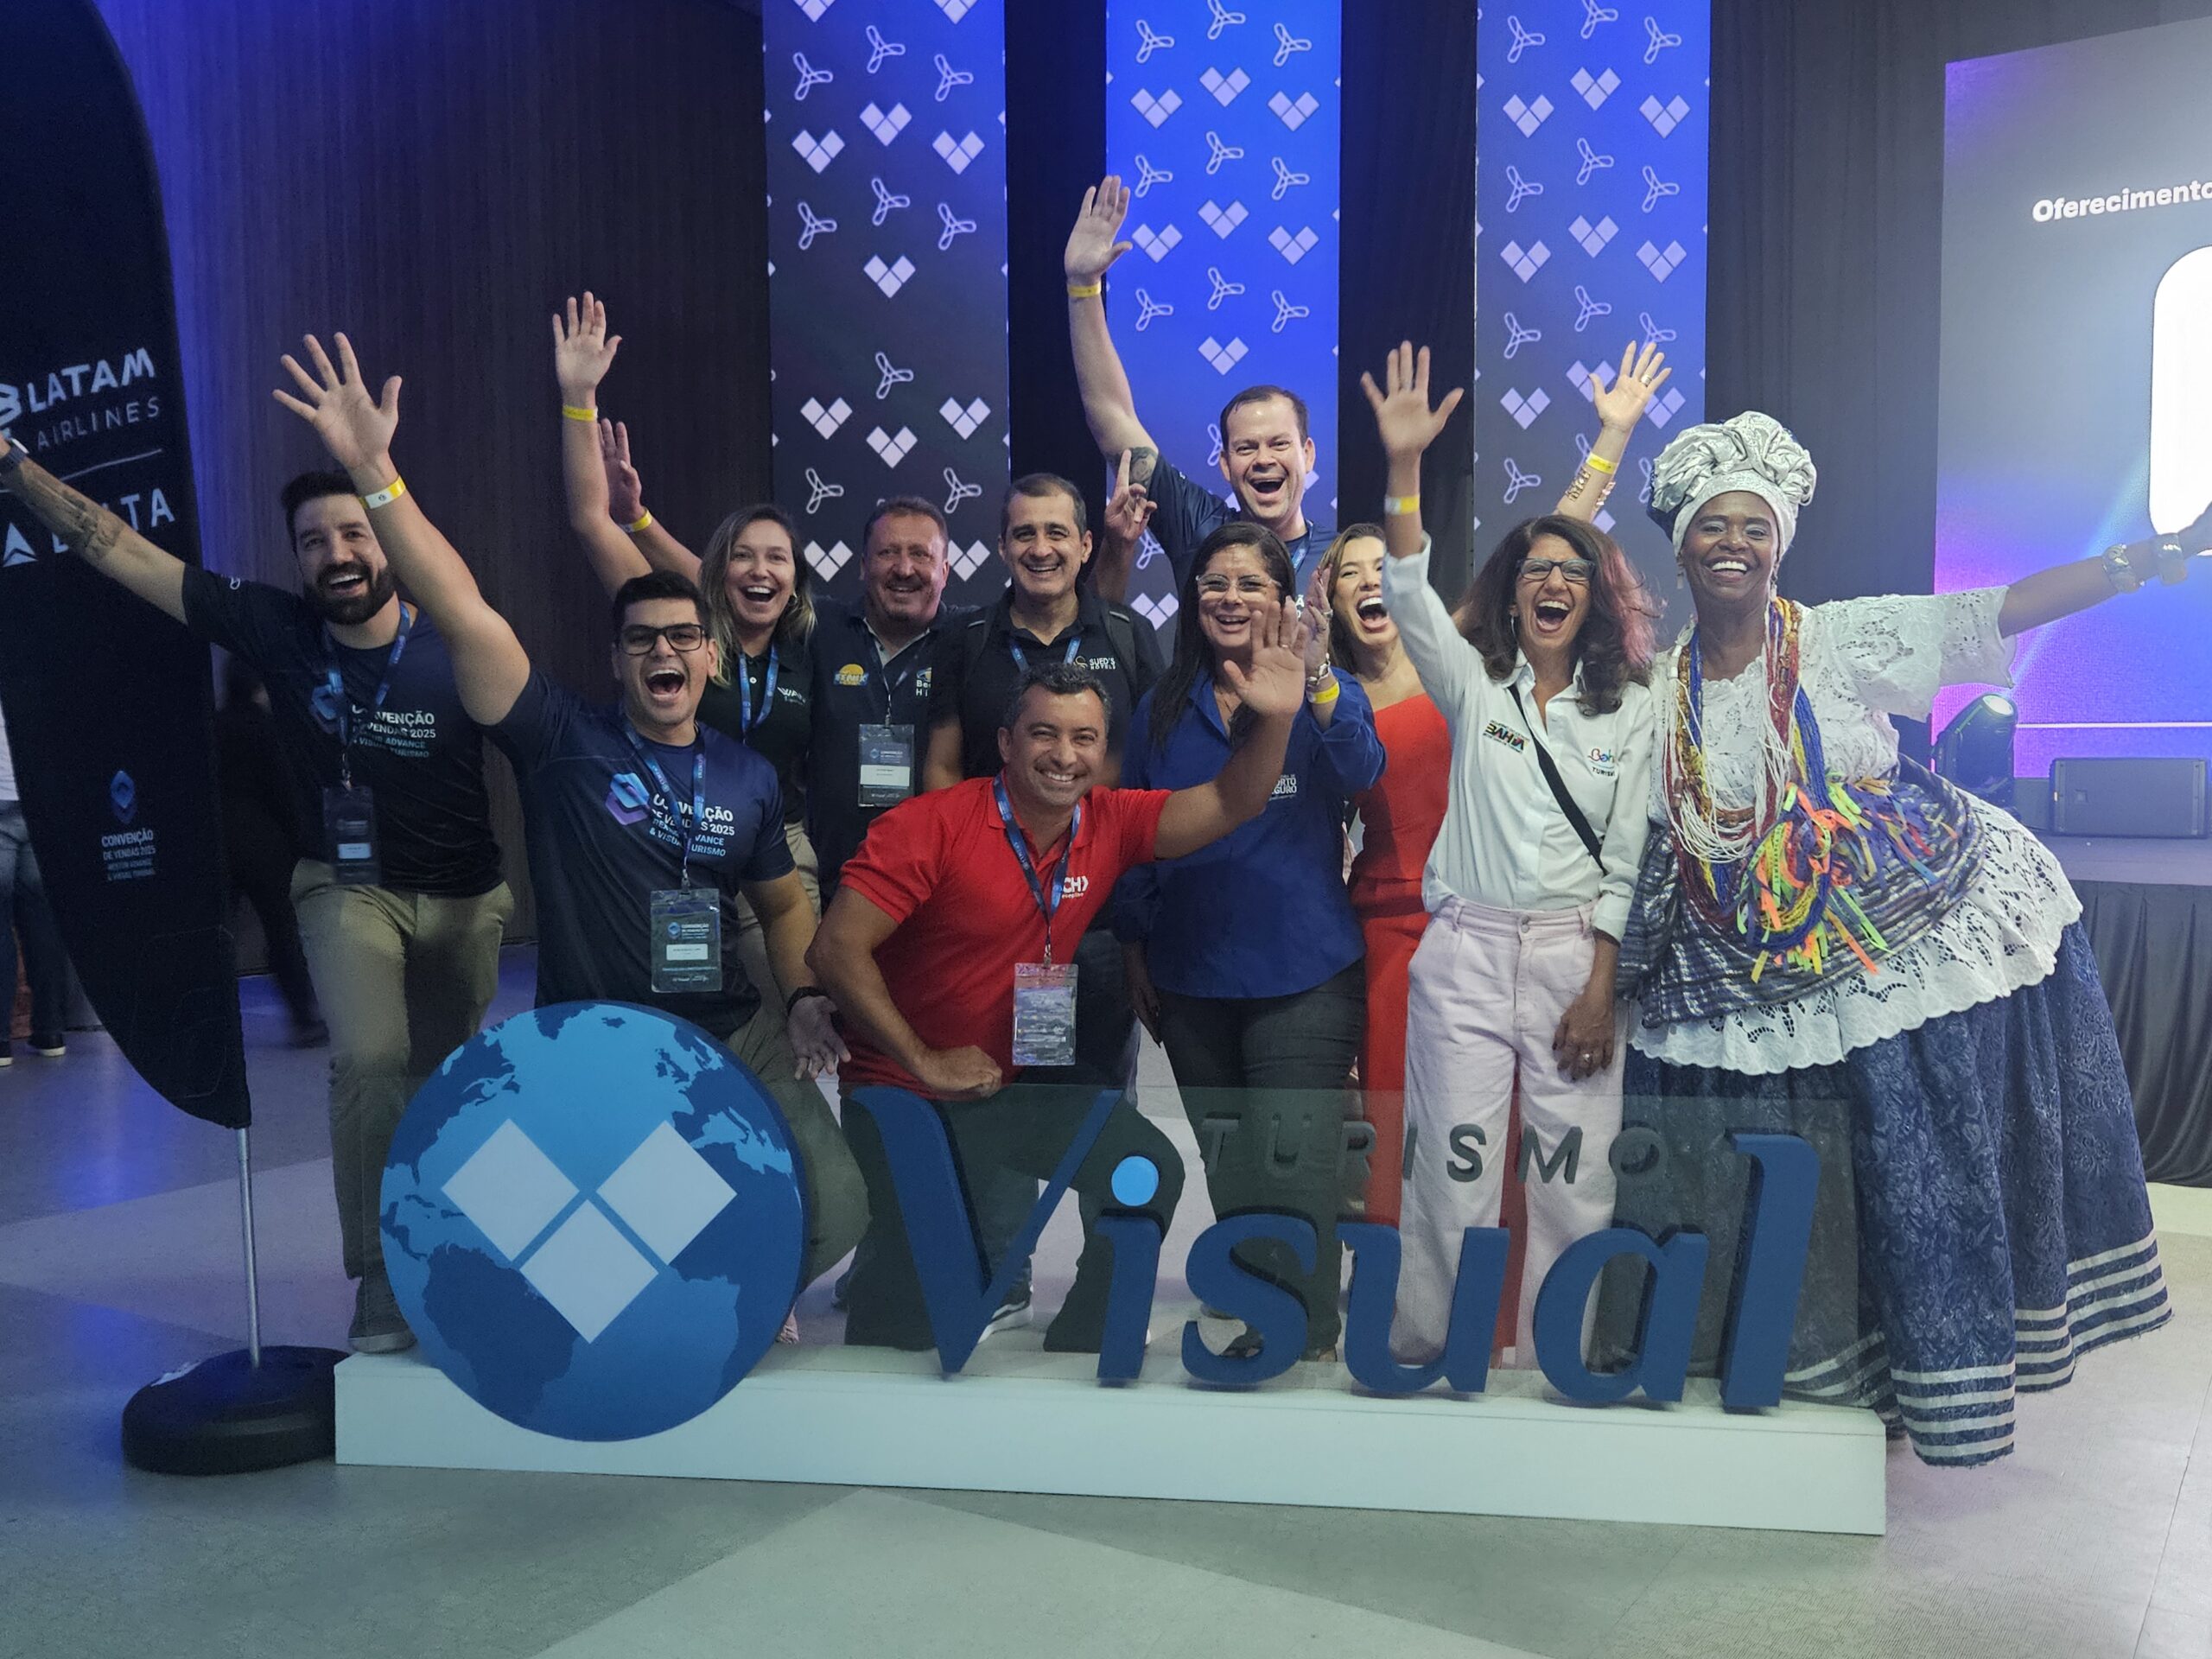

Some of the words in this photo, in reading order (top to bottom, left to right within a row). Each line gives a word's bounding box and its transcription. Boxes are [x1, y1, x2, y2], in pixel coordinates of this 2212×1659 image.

[28, 347, 156, 413] LATAM
[36, 397, 162, 451] AIRLINES
[410, 729, 436, 738] 2025
[691, 843, 726, 857] URISMO
[709, 823, 735, 836] 2025
[1201, 1113, 1669, 1187] TURISMO
[850, 1085, 1821, 1408] Visual
